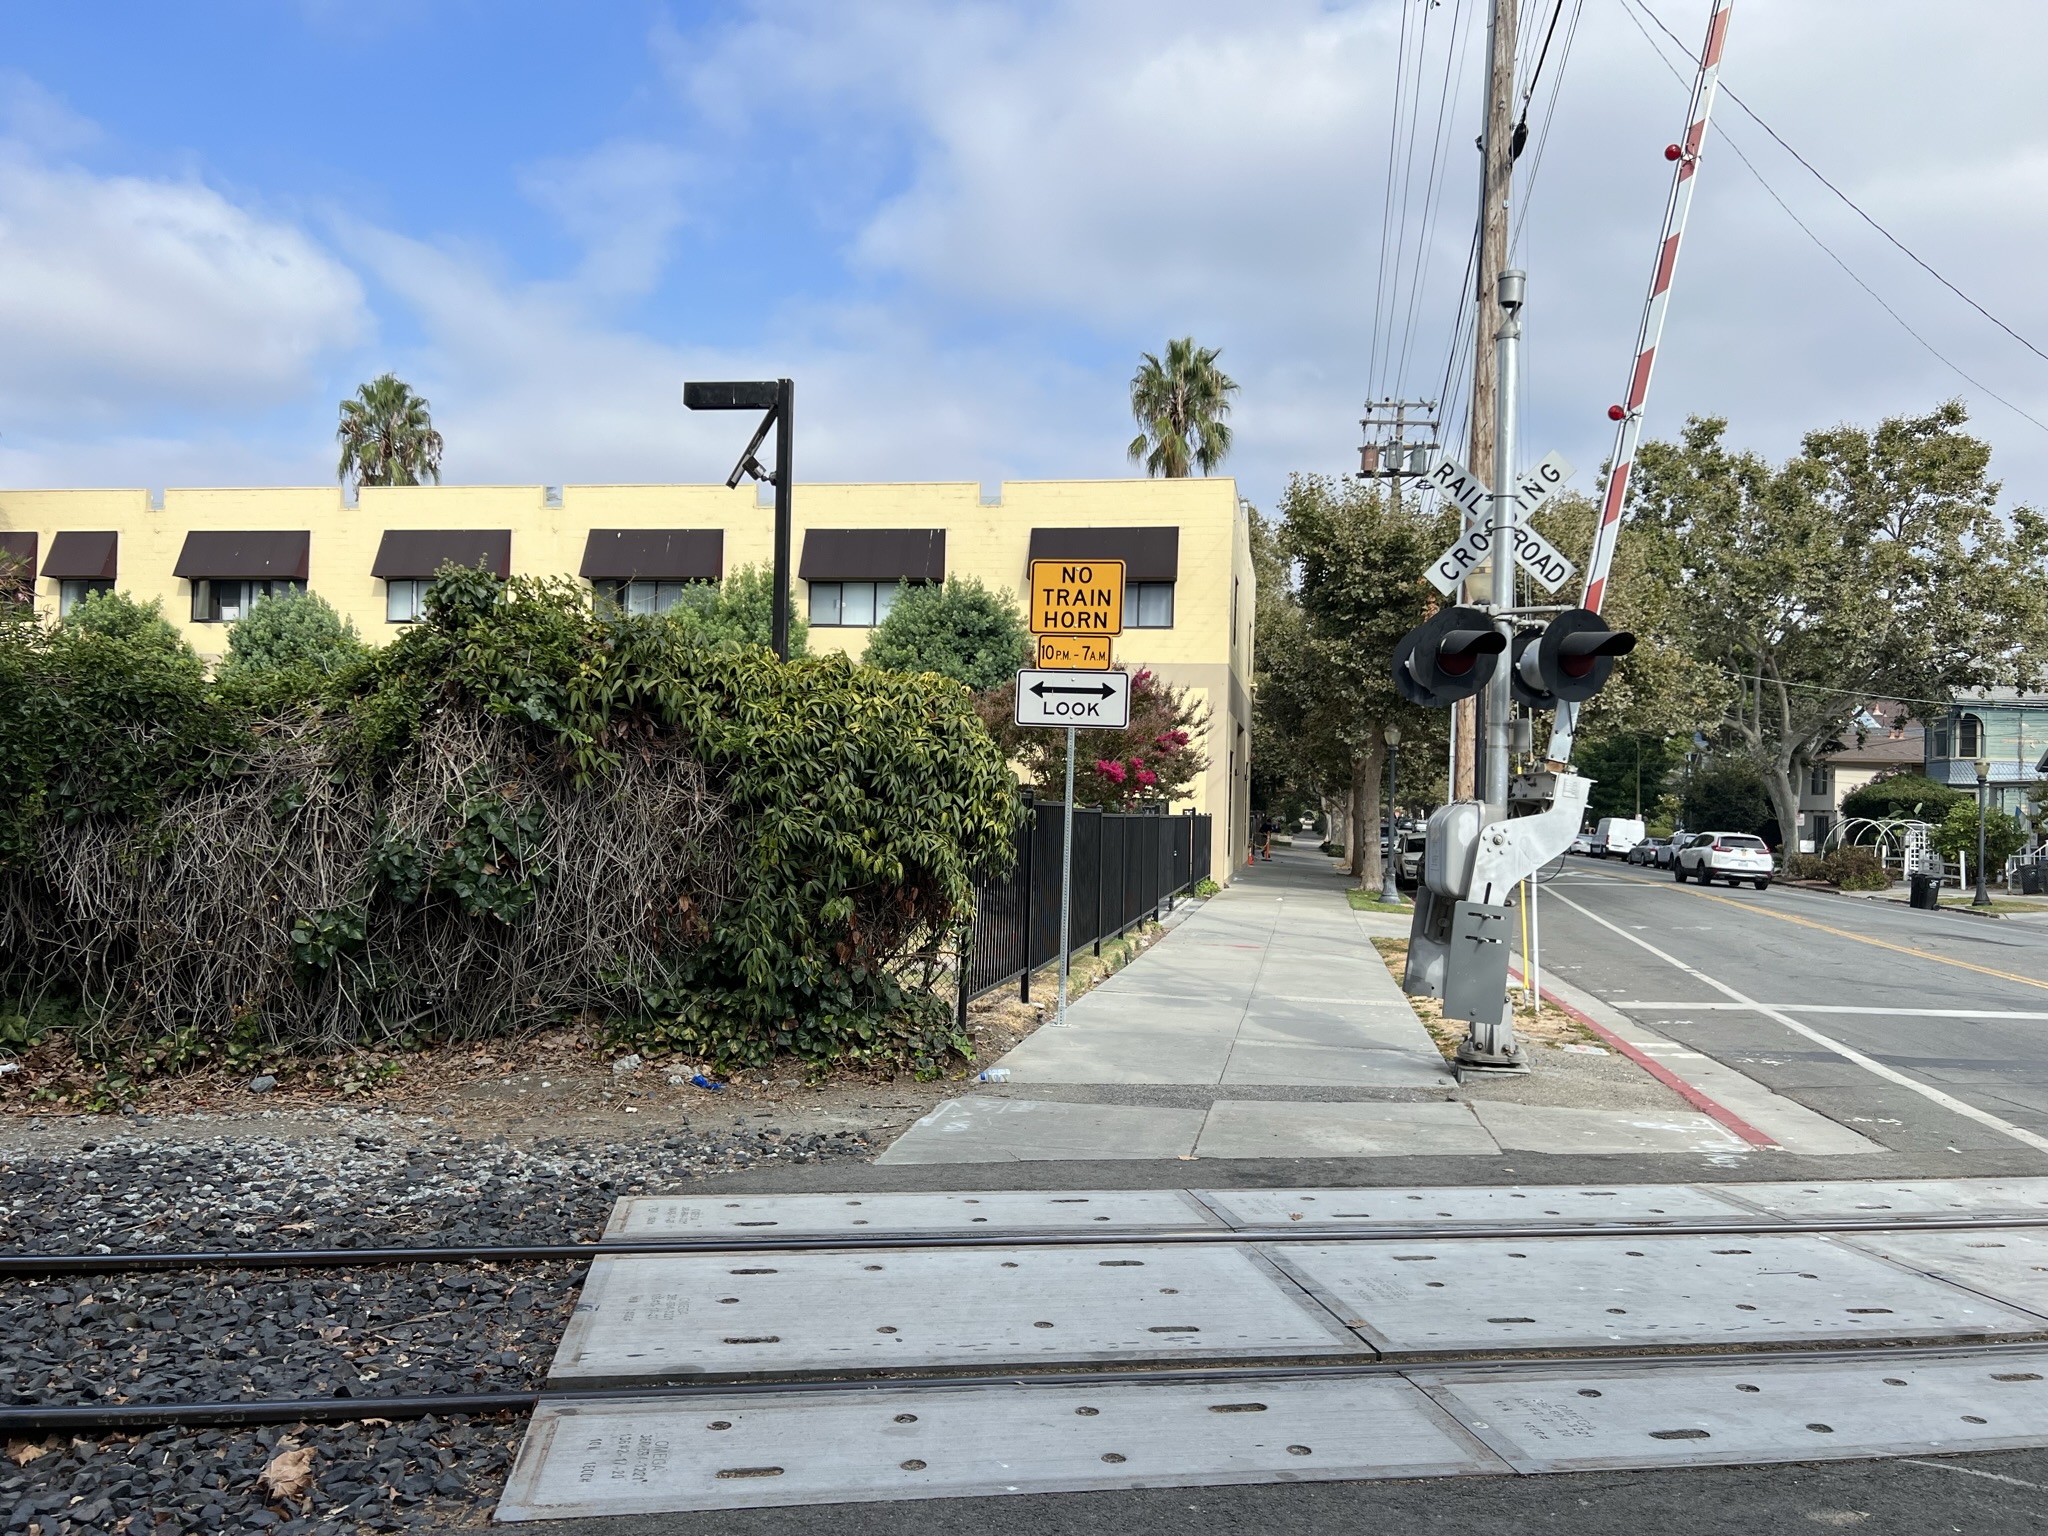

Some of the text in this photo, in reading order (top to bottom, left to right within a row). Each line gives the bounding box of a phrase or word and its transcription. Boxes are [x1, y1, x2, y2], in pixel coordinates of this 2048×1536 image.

[1440, 463, 1561, 581] CROING
[1062, 567, 1092, 584] NO
[1043, 589, 1112, 607] TRAIN
[1044, 611, 1108, 629] HORN
[1043, 701, 1100, 717] LOOK
[652, 1440, 670, 1471] OMEGA
